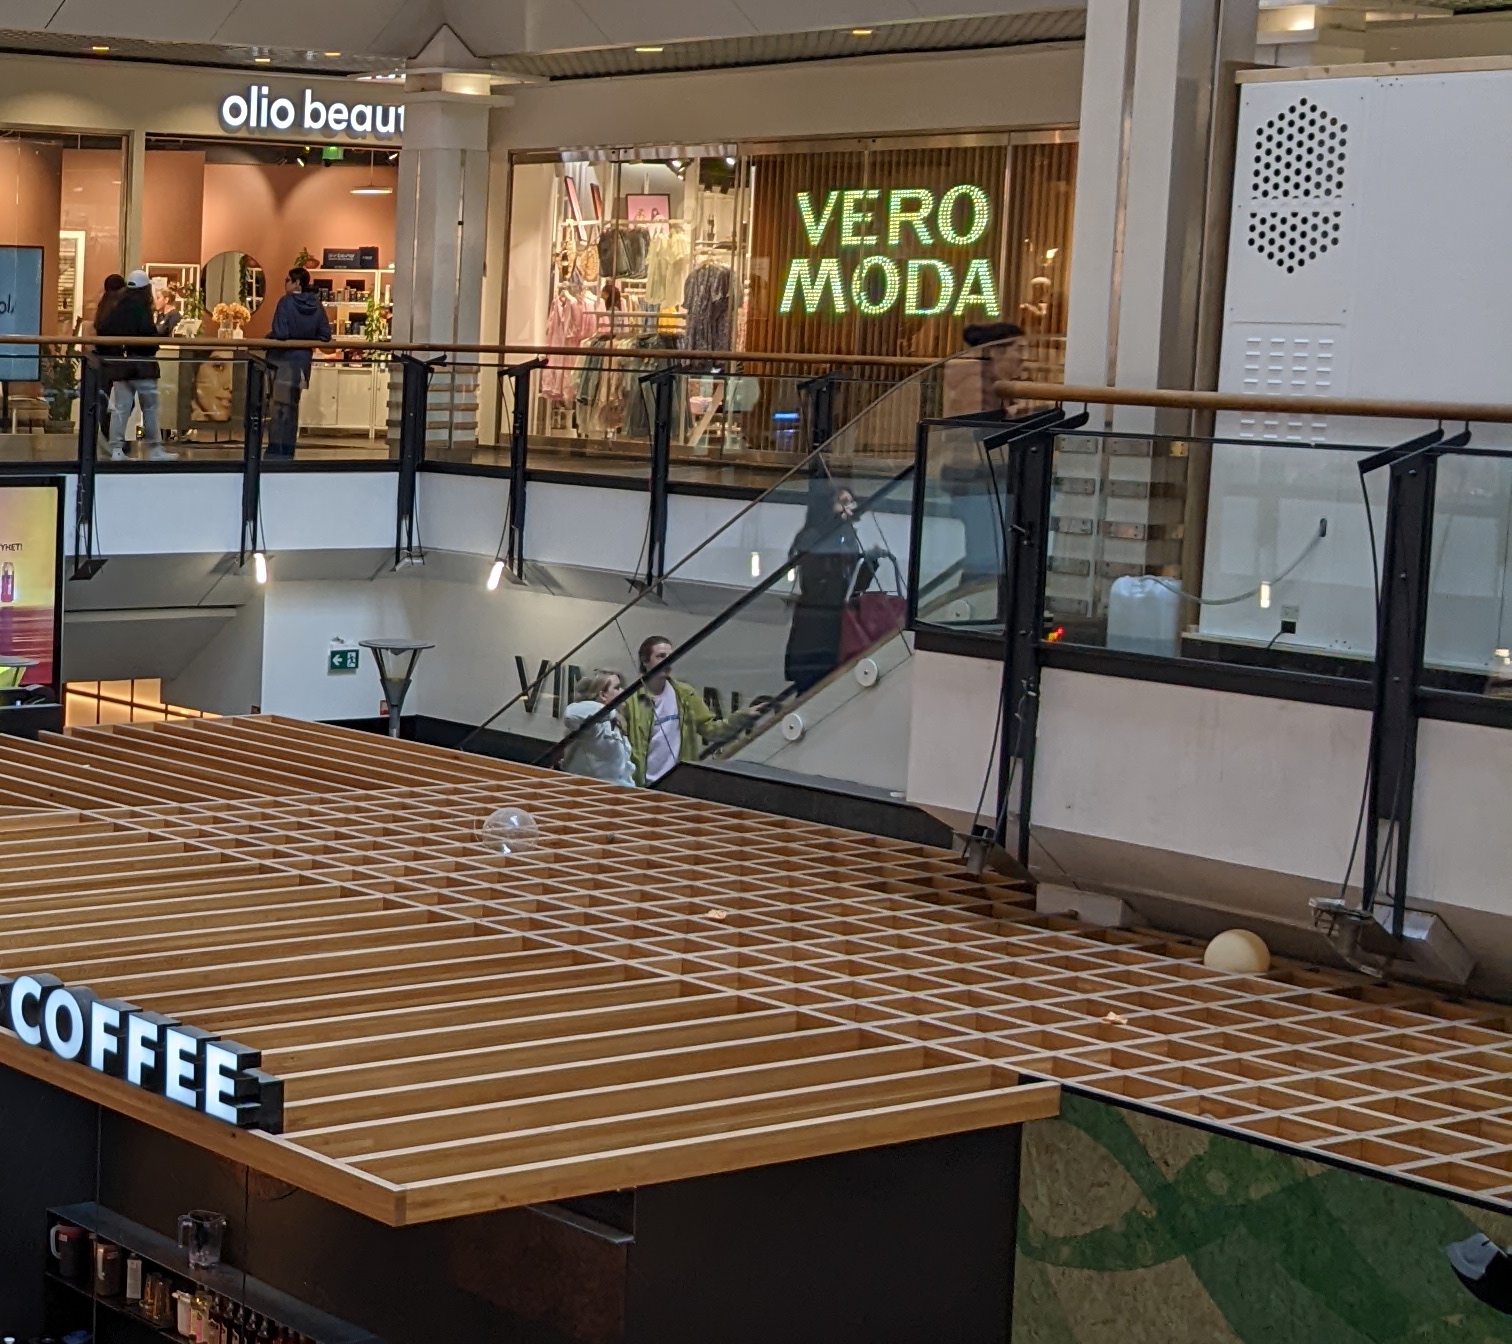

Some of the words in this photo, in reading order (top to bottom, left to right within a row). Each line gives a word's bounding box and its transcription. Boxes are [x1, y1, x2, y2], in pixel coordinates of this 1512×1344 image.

[222, 85, 295, 129] olio
[796, 184, 990, 246] VERO
[779, 255, 1001, 317] MODA
[9, 973, 240, 1125] COFFEE
